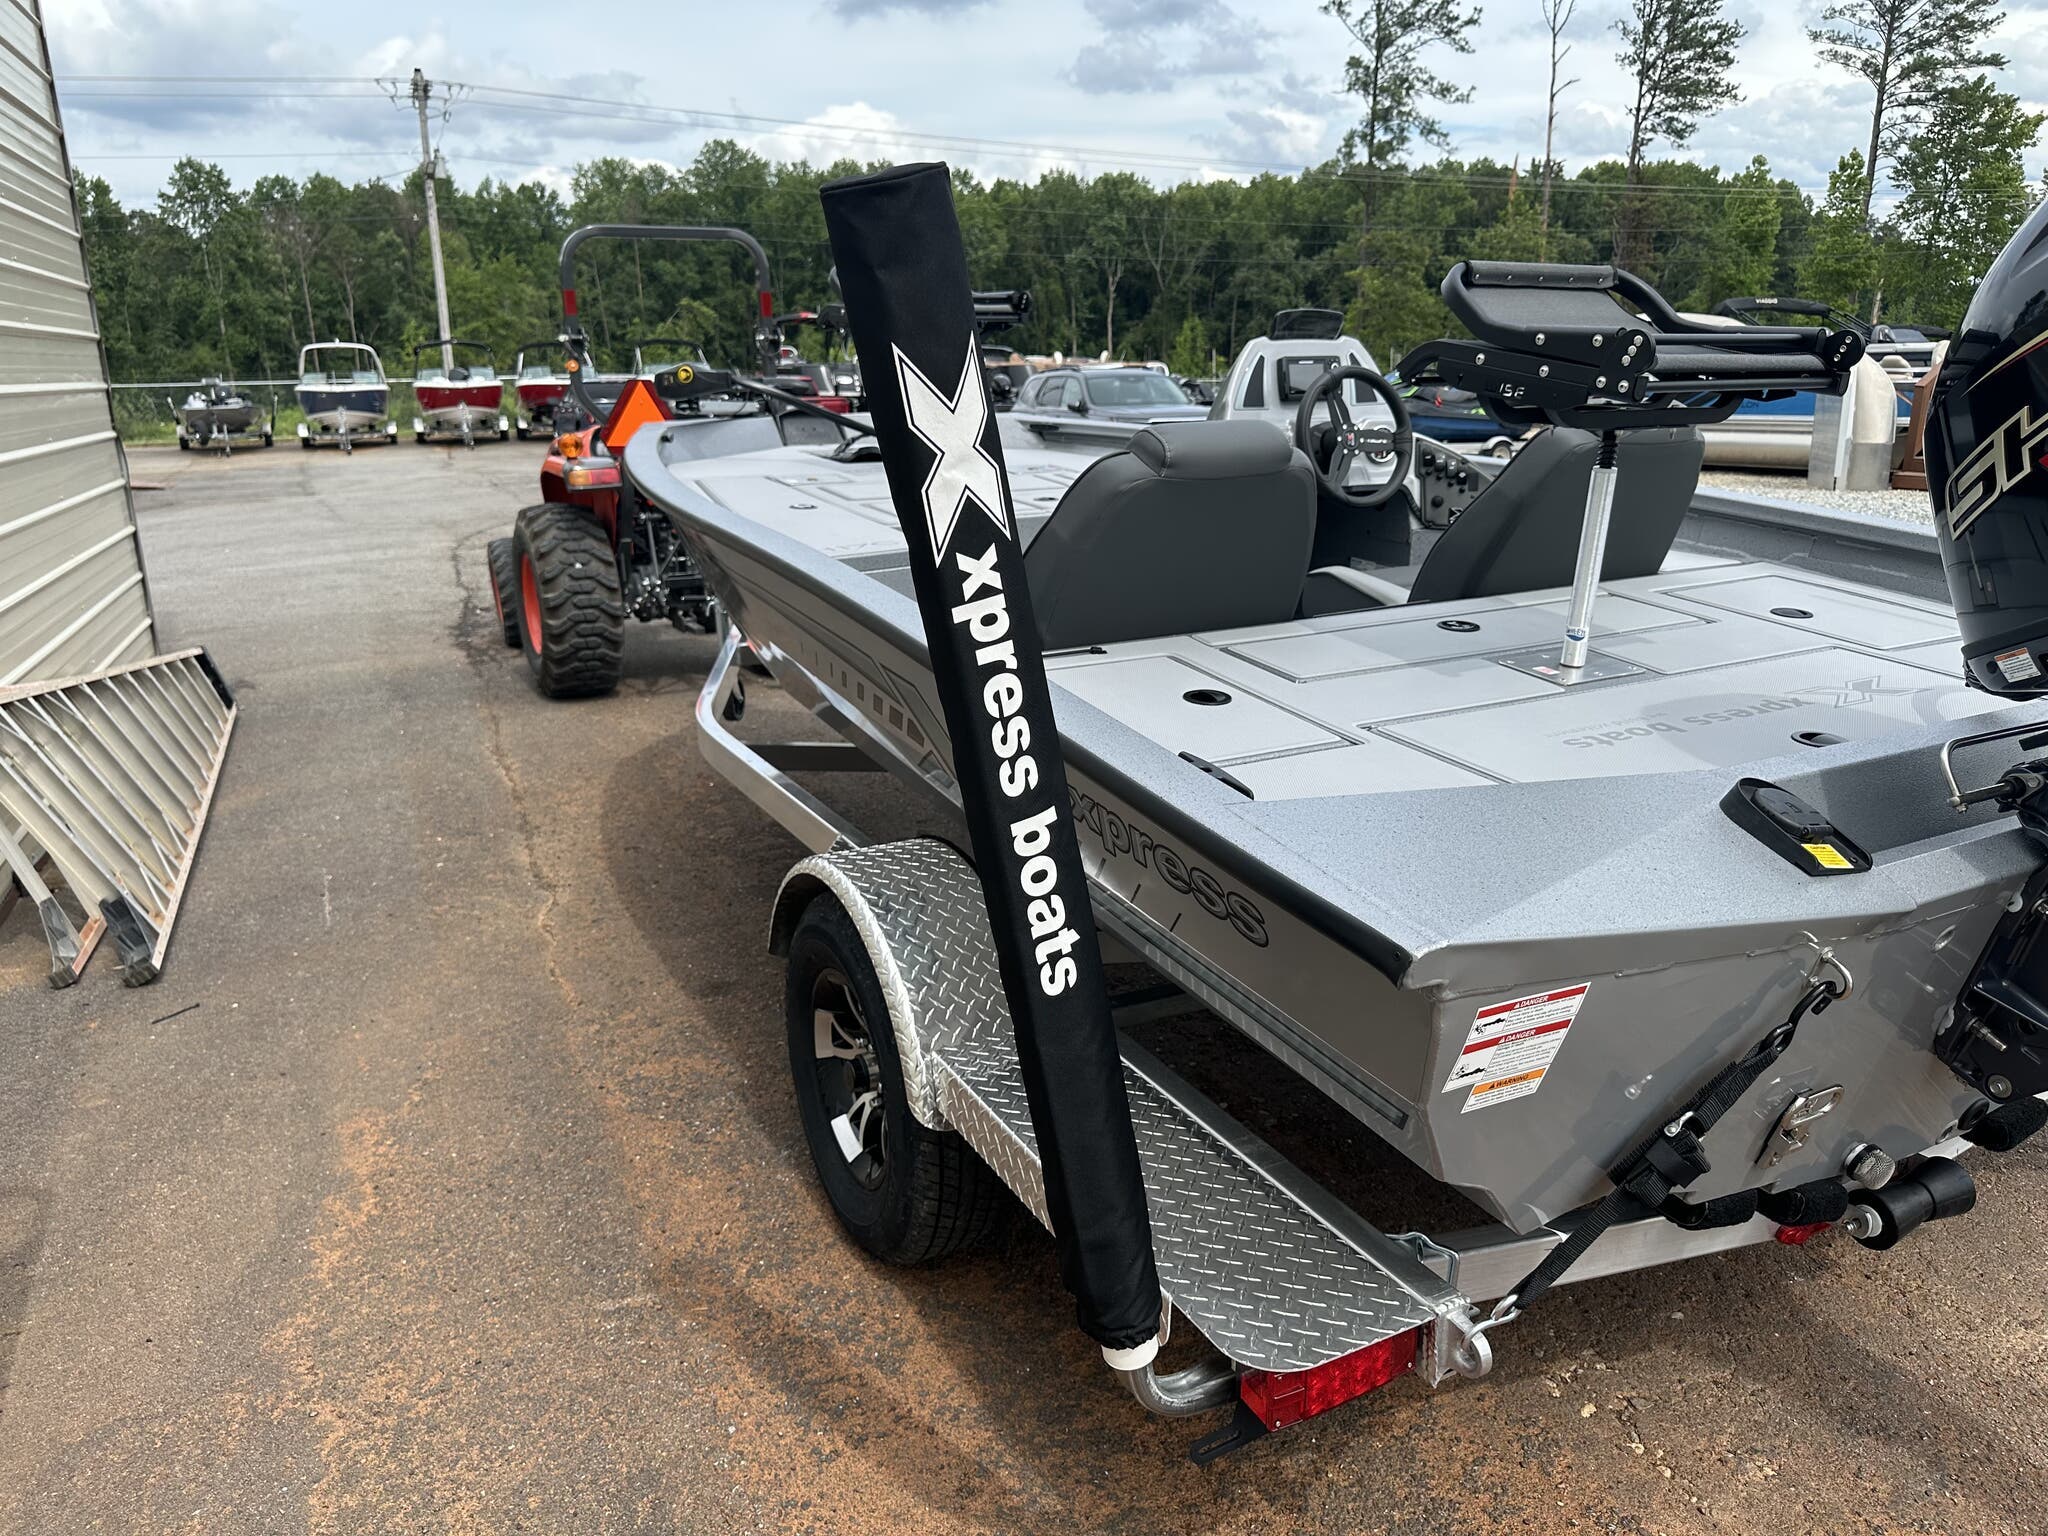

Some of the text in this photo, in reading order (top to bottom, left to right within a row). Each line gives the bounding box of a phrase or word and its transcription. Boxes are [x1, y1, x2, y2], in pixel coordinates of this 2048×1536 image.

[1683, 697, 1816, 726] xpress
[1562, 722, 1688, 748] boats
[951, 542, 1039, 798] xpress
[1010, 805, 1081, 997] boats
[1066, 784, 1270, 948] xpress
[1520, 996, 1549, 1008] DANGER
[1505, 1029, 1536, 1042] DANGER
[1496, 1072, 1529, 1087] WARNING
